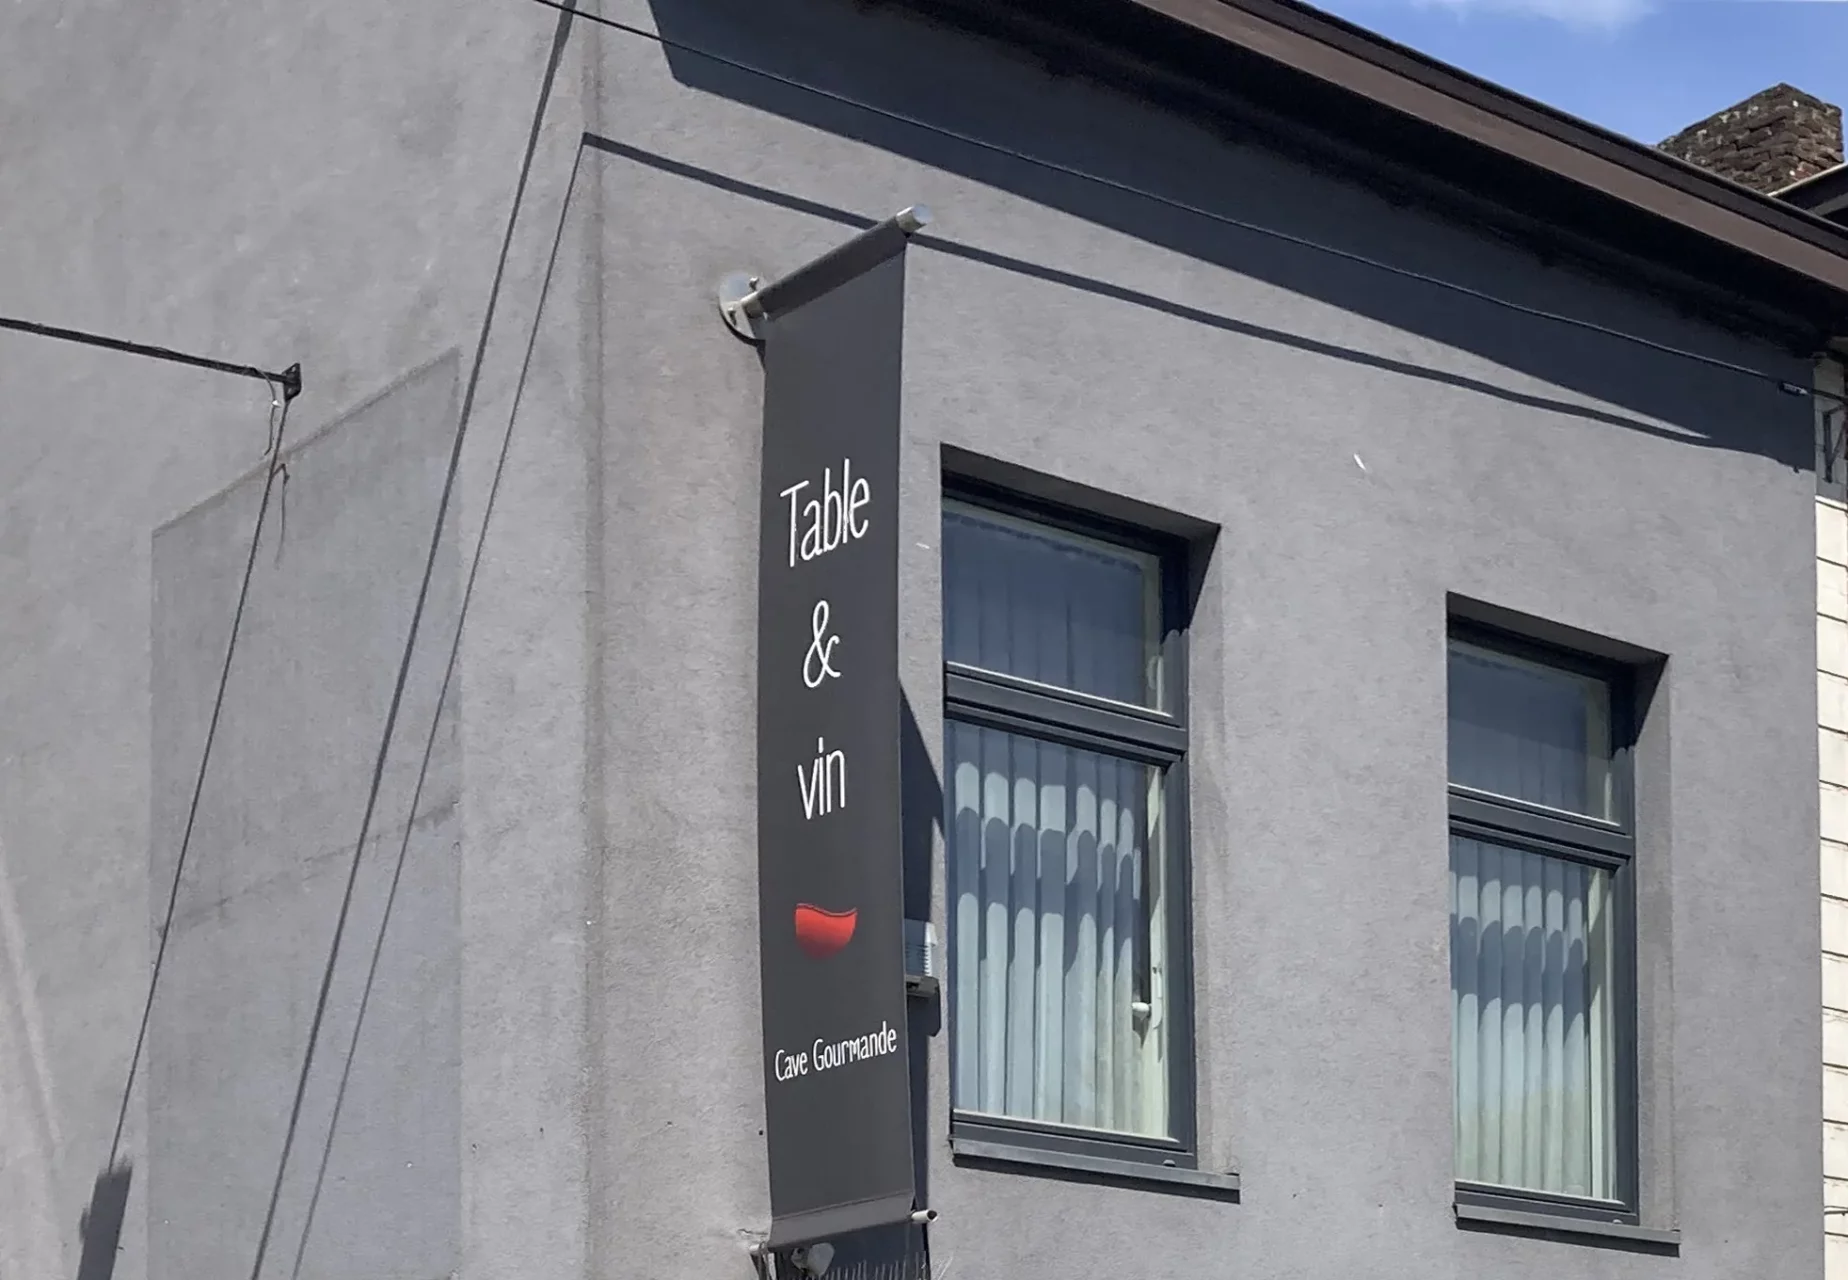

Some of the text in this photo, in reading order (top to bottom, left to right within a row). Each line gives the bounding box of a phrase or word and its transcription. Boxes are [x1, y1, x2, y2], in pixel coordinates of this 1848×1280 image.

[780, 458, 870, 567] Table
[803, 600, 841, 688] &
[798, 736, 845, 820] vin
[775, 1020, 897, 1081] Cave Gourmande
